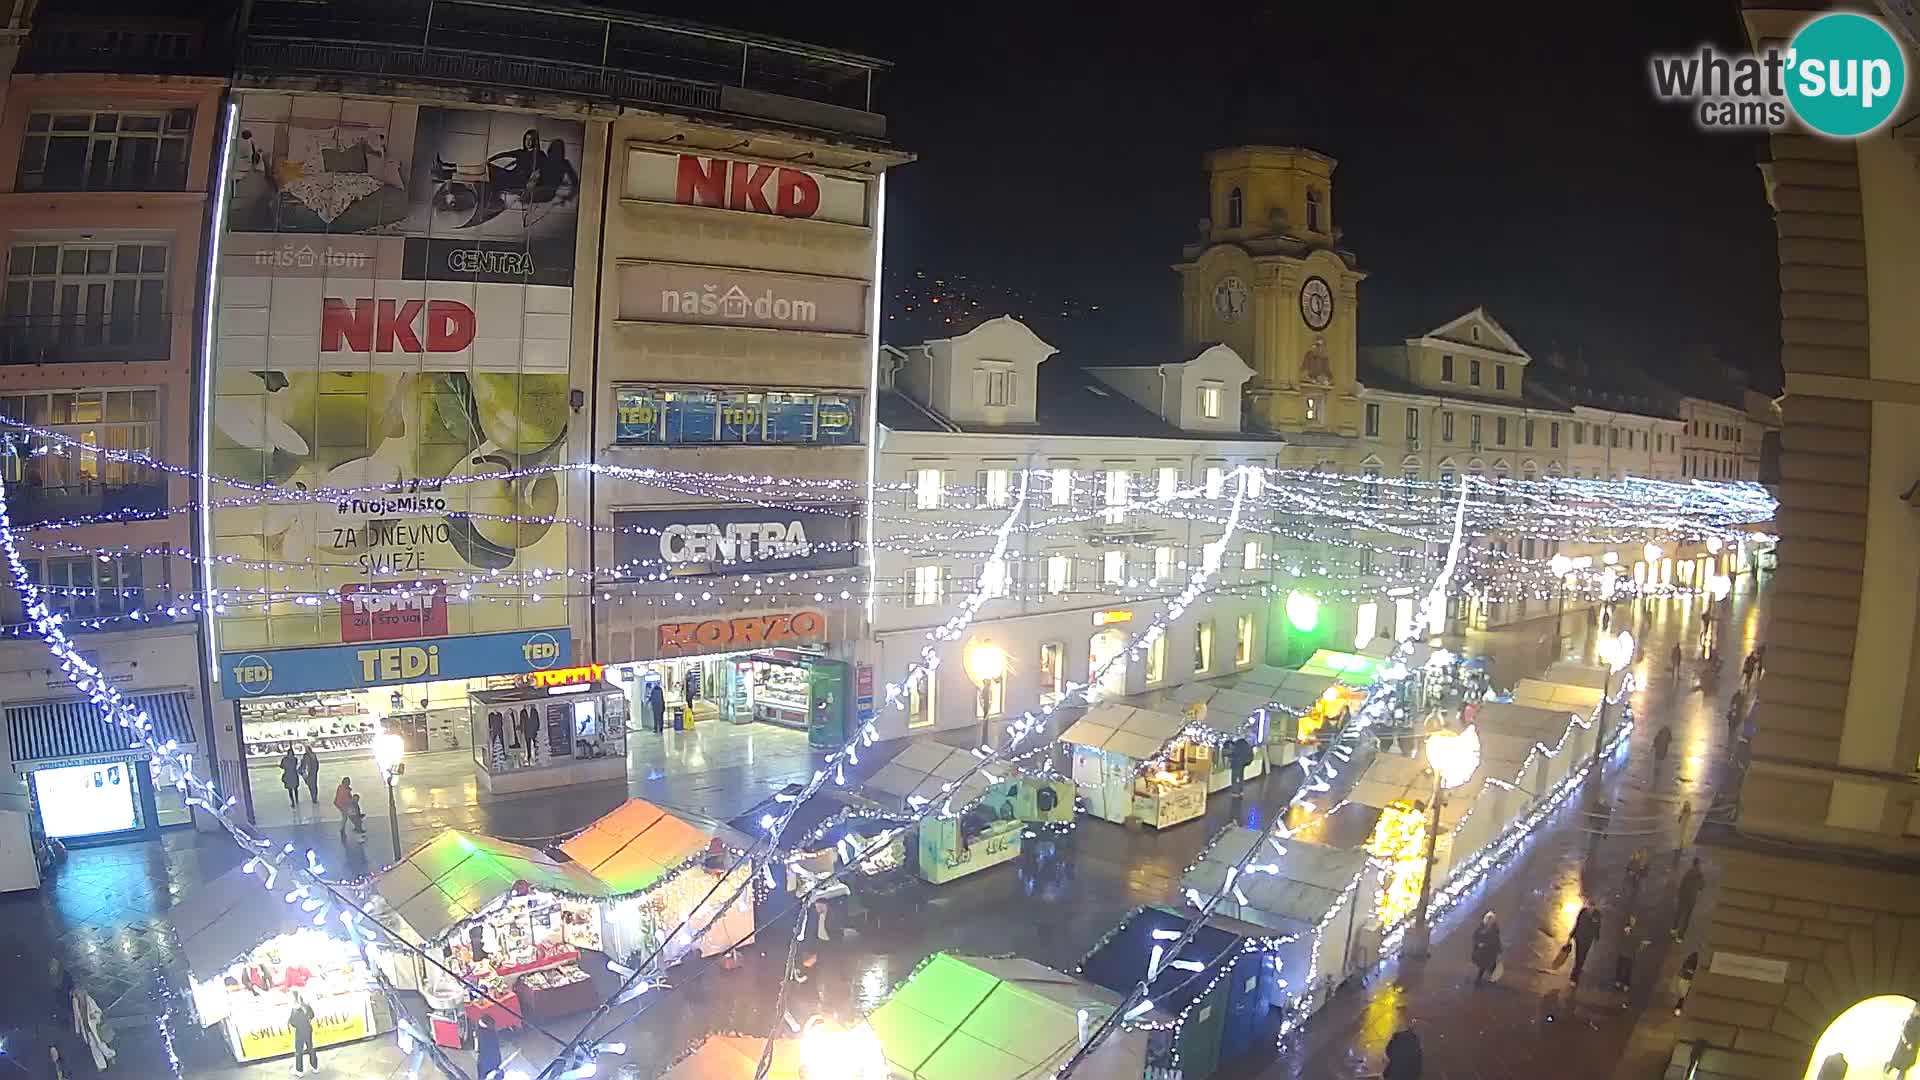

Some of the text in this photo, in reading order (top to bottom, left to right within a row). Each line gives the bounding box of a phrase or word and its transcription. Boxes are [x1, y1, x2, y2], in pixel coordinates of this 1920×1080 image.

[677, 154, 820, 218] NKD
[447, 249, 535, 275] CENTRA
[320, 298, 476, 352] NKD
[333, 523, 450, 548] ZA DNEVNO
[660, 521, 809, 562] CENTRA
[660, 611, 826, 649] KORZO
[233, 666, 273, 684] TEDi
[358, 645, 440, 681] TEDi
